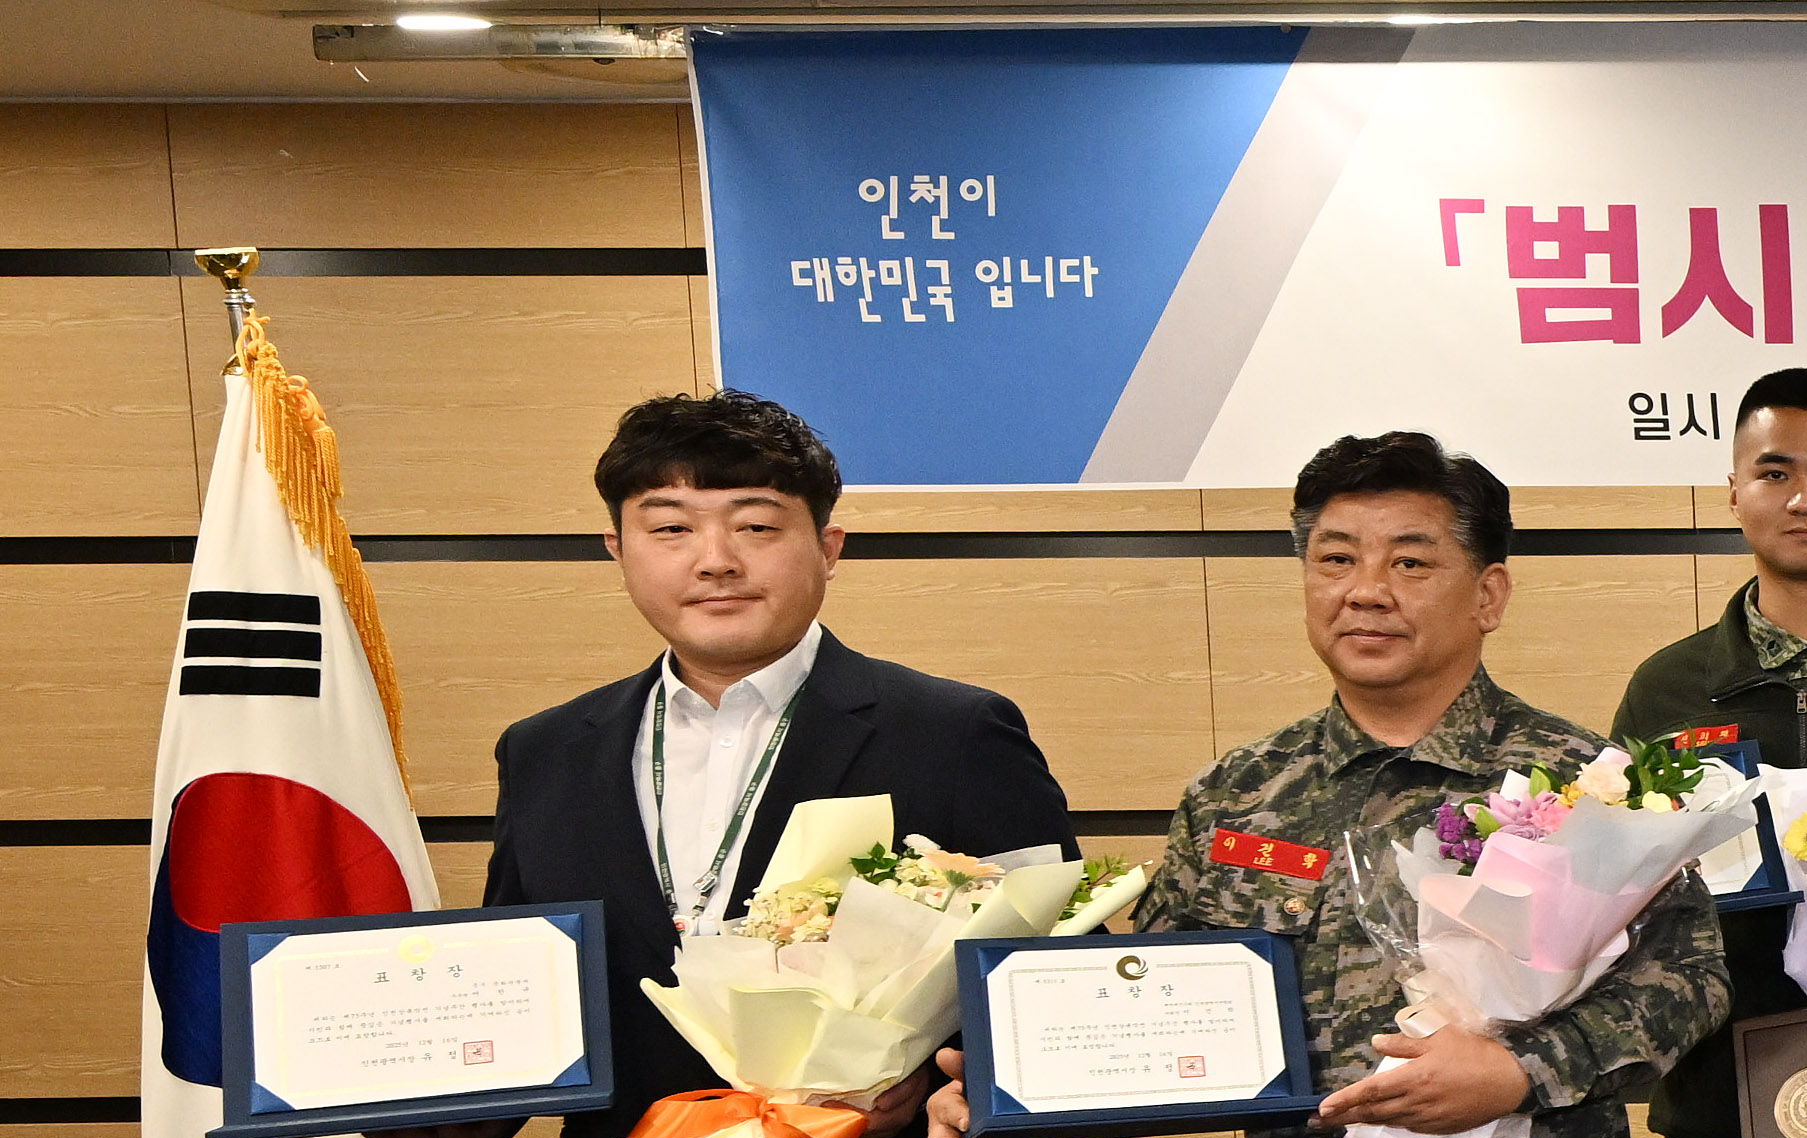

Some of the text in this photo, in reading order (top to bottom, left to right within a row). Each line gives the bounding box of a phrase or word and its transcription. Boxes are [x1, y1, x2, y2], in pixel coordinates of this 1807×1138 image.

[857, 174, 997, 240] 인천이
[790, 256, 1100, 323] 대한민국 입니다
[1628, 392, 1722, 442] 일시
[1252, 857, 1275, 866] LEE
